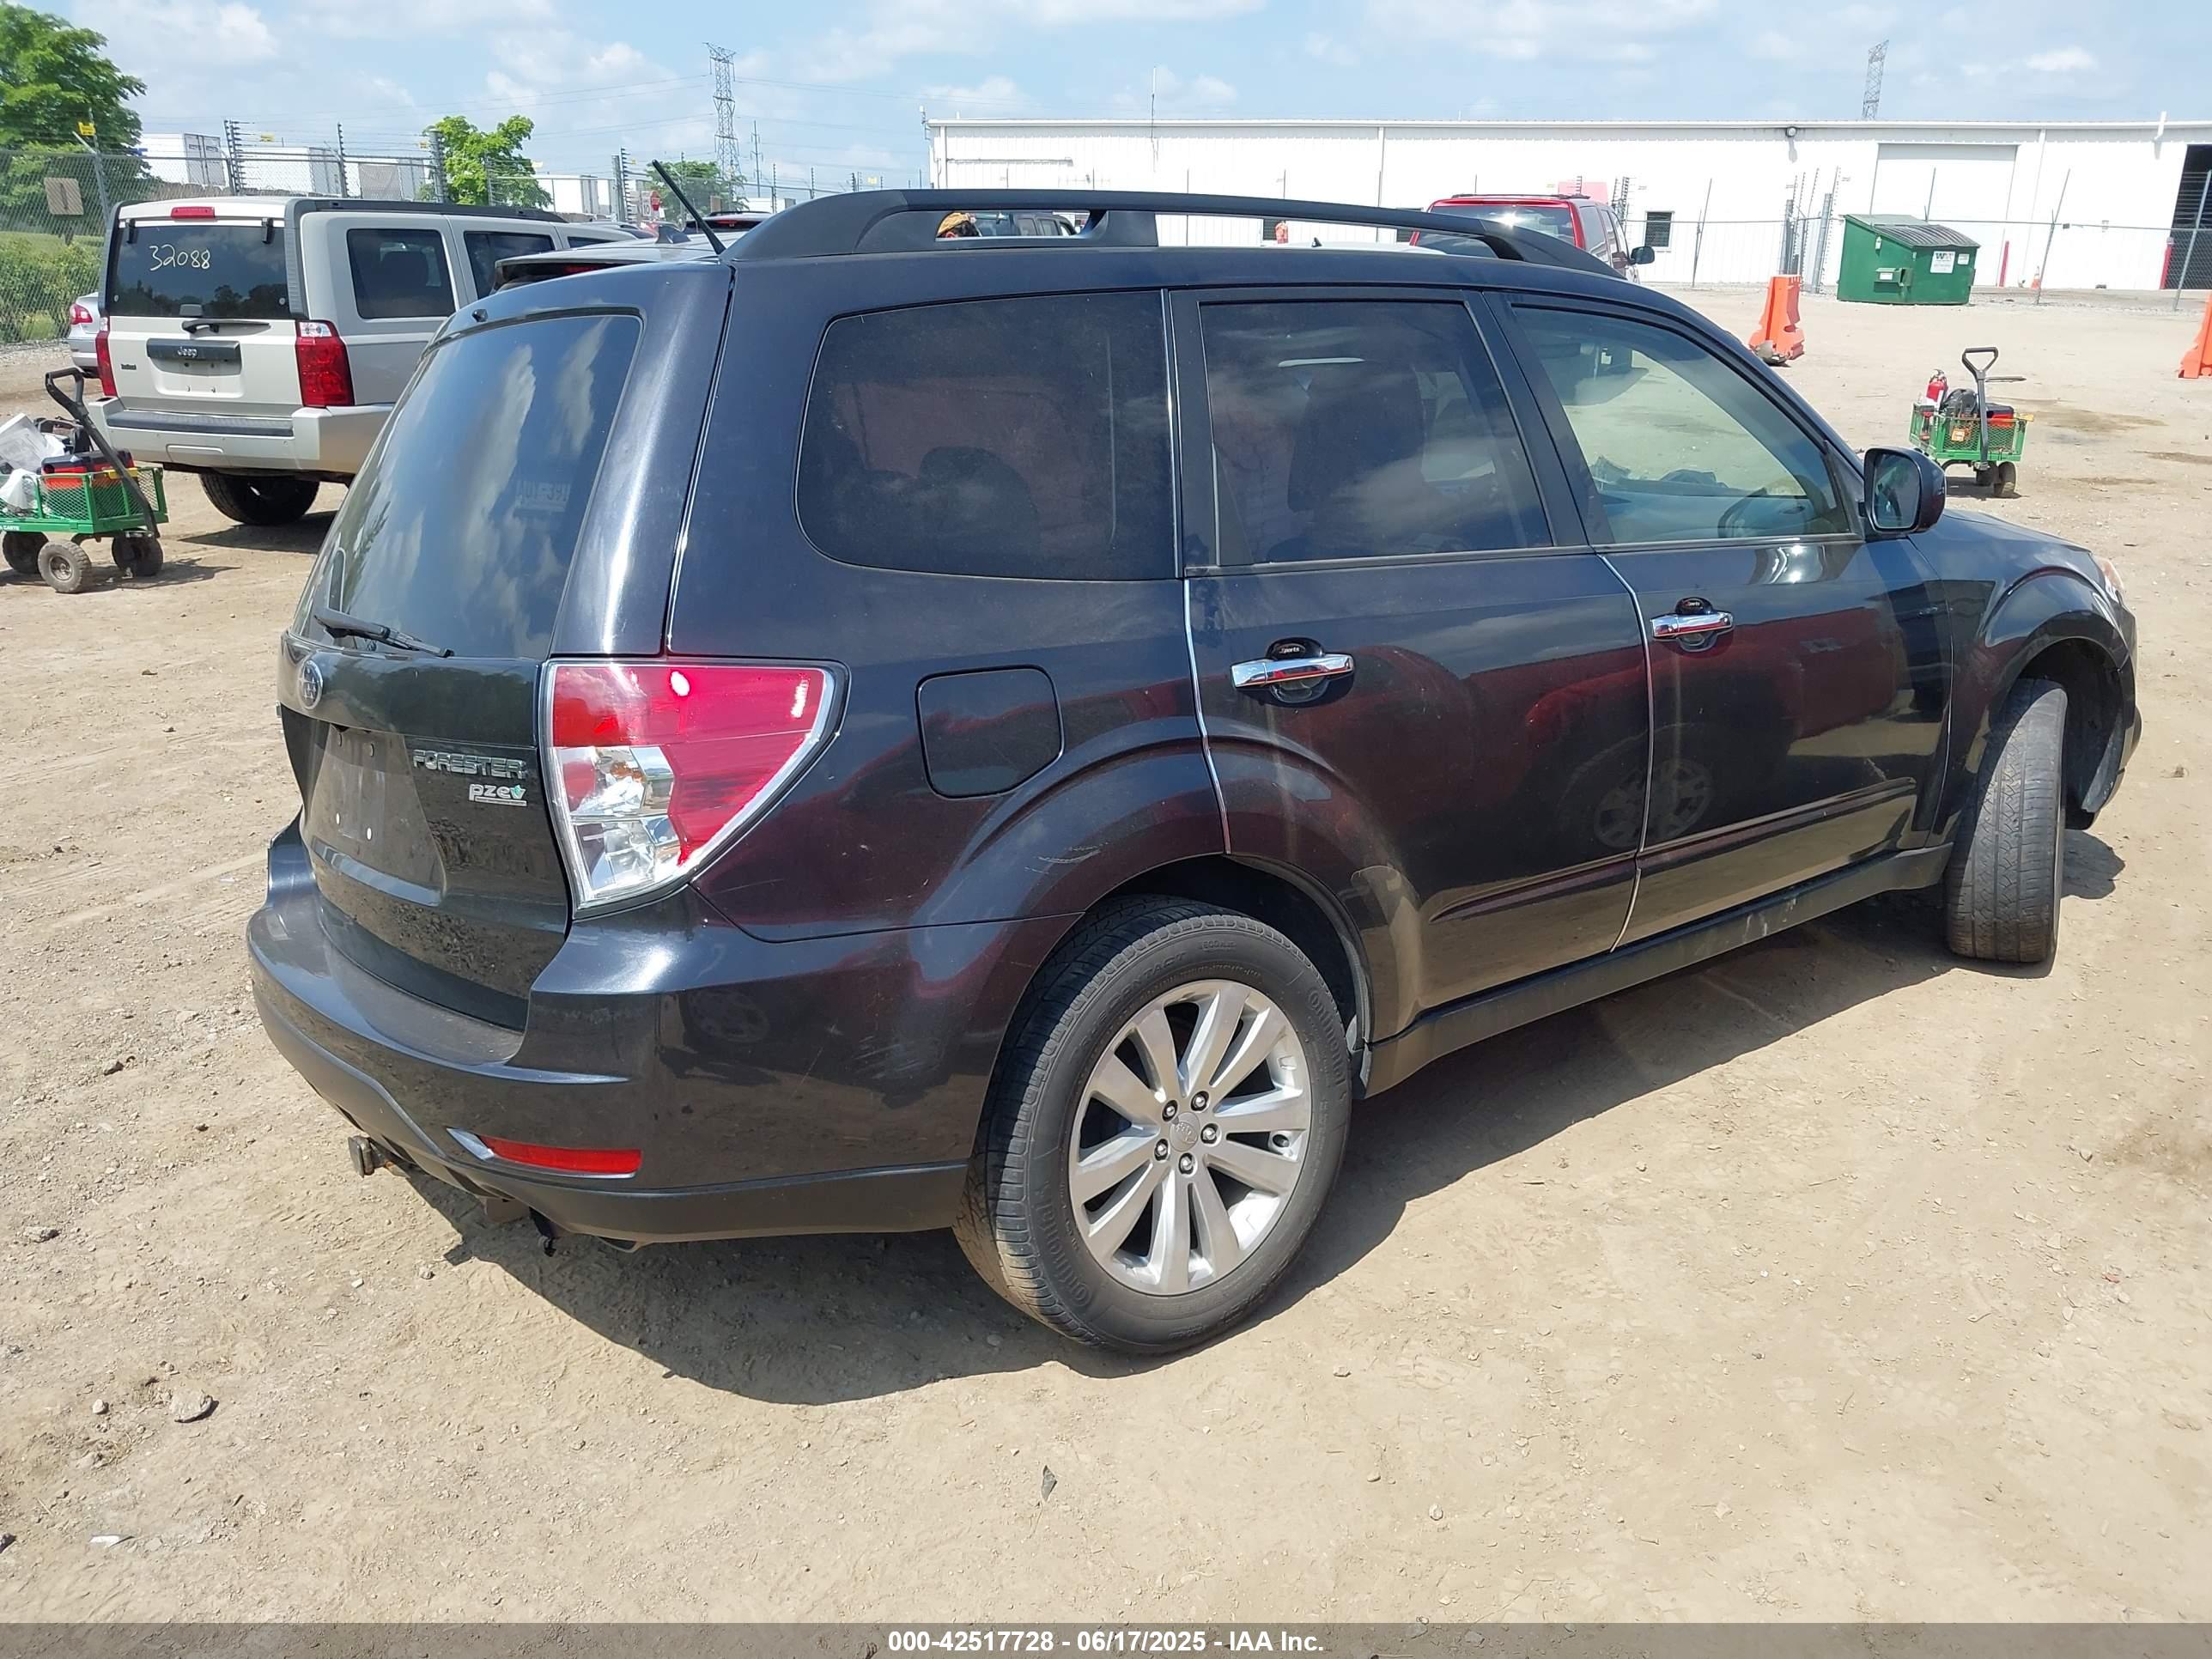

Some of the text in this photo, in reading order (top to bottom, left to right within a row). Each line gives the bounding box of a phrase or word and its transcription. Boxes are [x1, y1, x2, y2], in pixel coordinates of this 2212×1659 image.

[149, 244, 210, 270] 32088
[177, 346, 198, 358] Jeep
[413, 749, 524, 780] FORESTER
[469, 783, 526, 801] pzev
